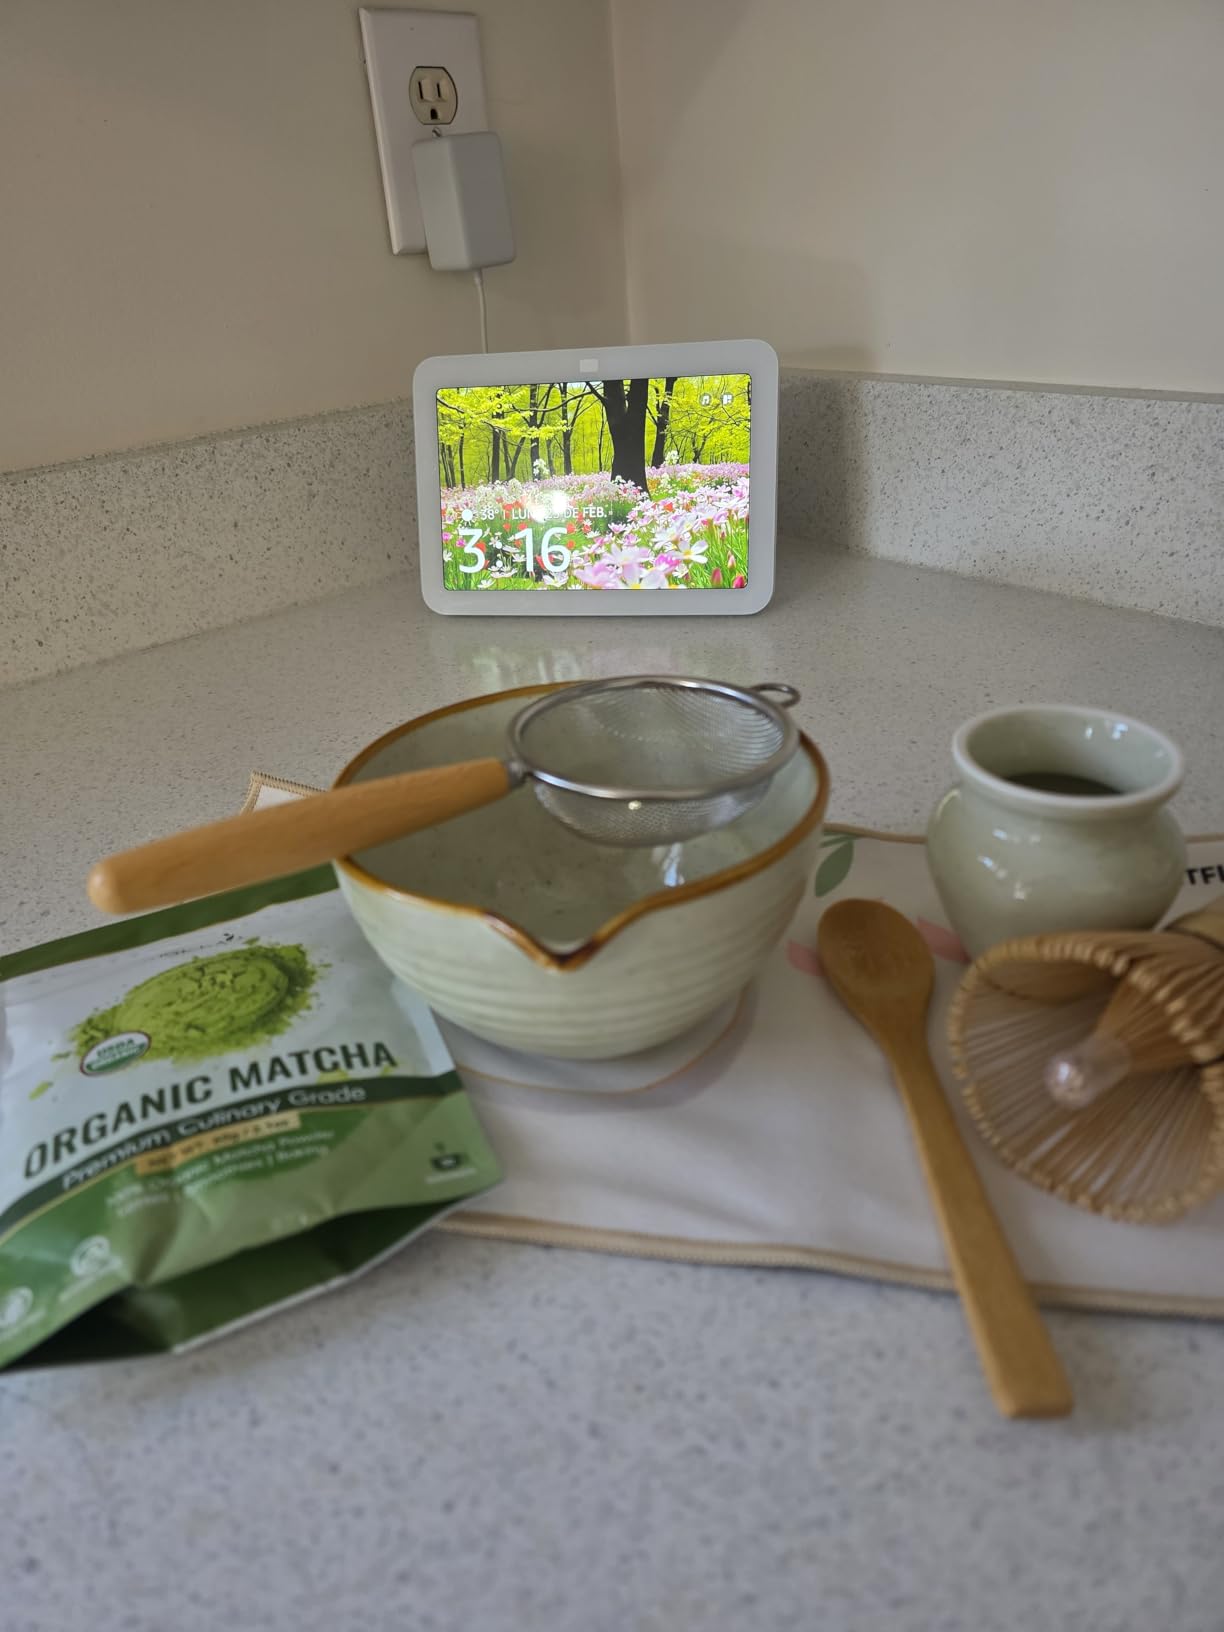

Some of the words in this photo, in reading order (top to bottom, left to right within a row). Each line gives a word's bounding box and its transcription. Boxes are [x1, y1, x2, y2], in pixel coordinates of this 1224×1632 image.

[458, 527, 571, 574] 3:16
[565, 507, 579, 519] DE
[582, 507, 607, 519] FEB.
[24, 1076, 213, 1179] ORGANIC
[228, 1041, 398, 1093] MATCHA
[61, 1128, 171, 1189] Premium
[177, 1100, 281, 1136] Culinary
[287, 1085, 366, 1106] Grade
